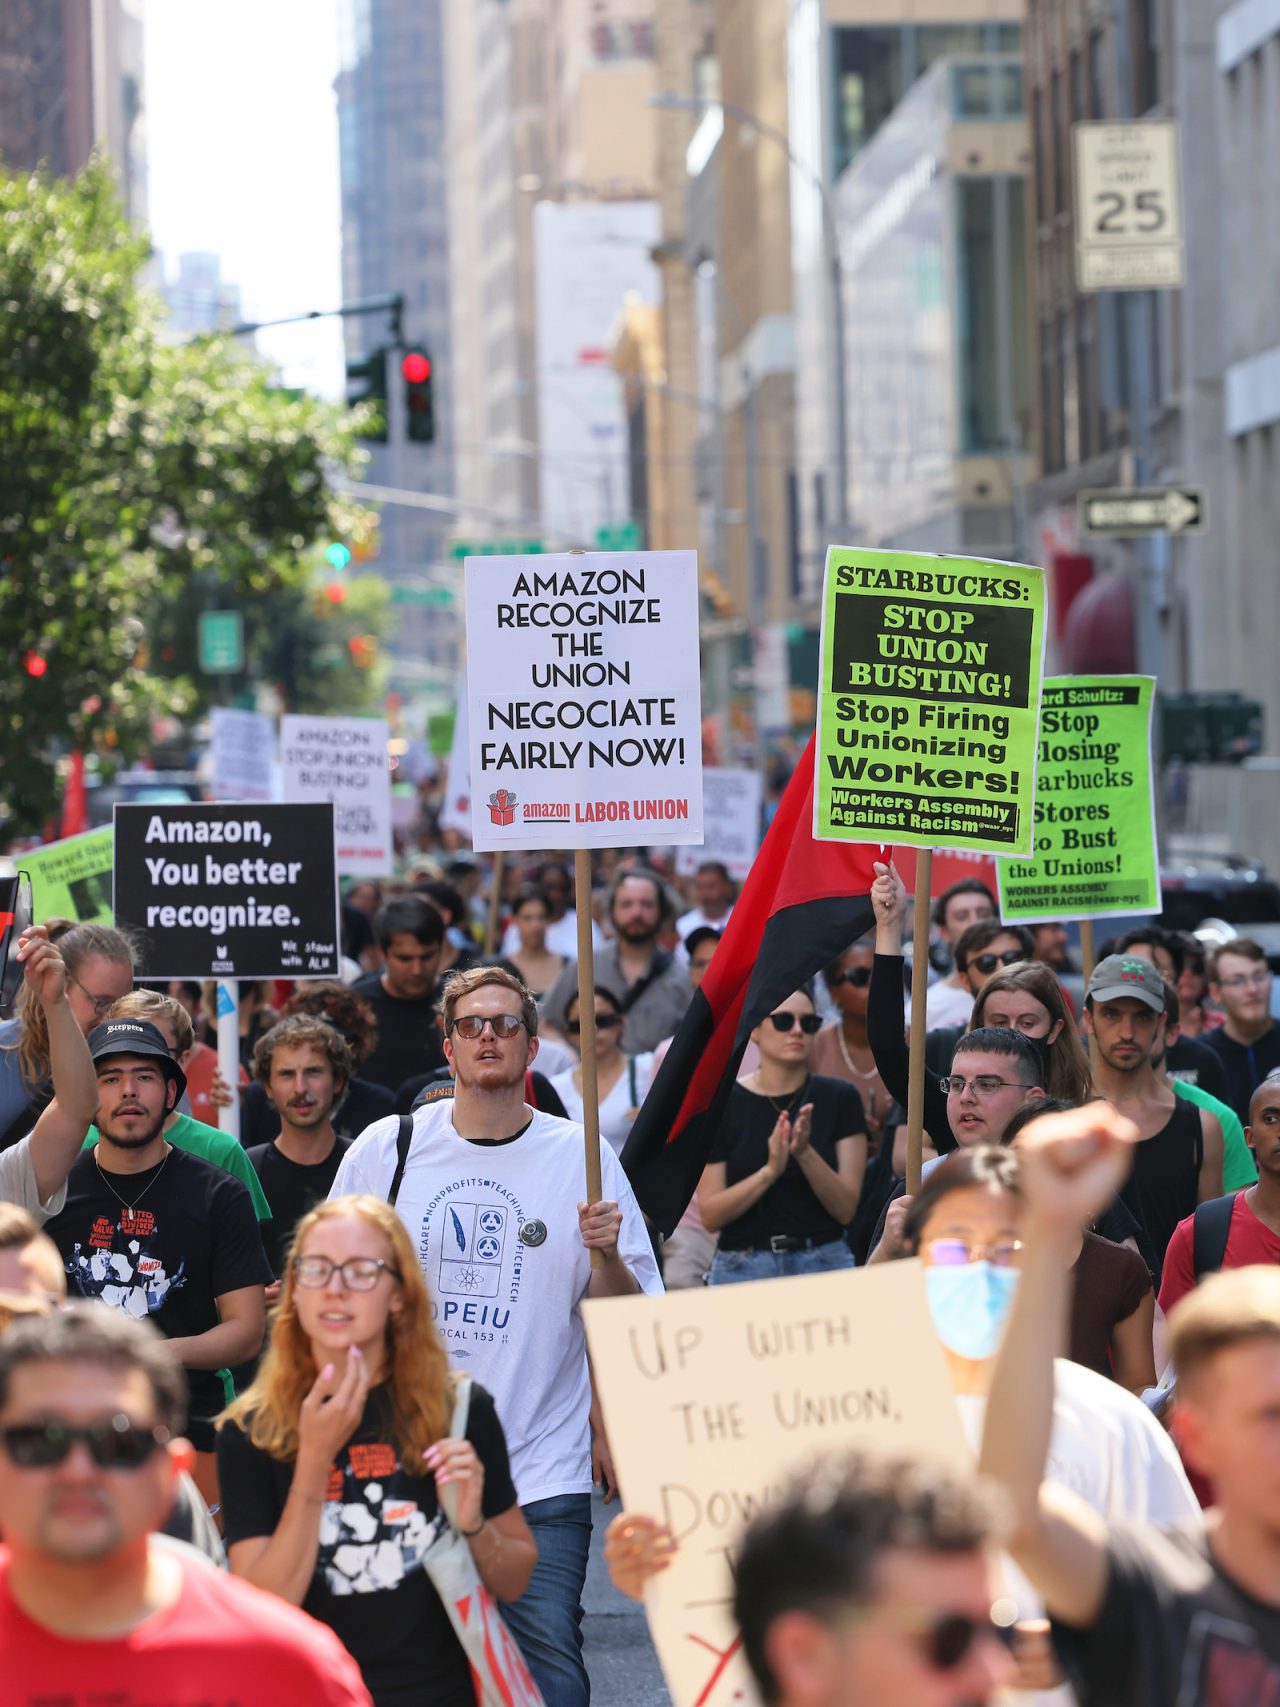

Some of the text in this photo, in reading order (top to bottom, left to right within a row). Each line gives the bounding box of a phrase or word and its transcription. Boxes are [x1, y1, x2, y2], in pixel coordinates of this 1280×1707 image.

[1095, 191, 1166, 233] 25
[512, 569, 645, 597] AMAZON
[836, 565, 1030, 601] STARBUCKS:
[497, 599, 661, 628] RECOGNIZE
[883, 604, 975, 634] STOP
[551, 632, 603, 657] THE
[877, 634, 988, 665] UNION
[532, 661, 630, 688] UNION
[849, 662, 1012, 698] BUSTING!
[1041, 690, 1125, 704] ard Schultz:
[488, 698, 676, 730] NEGOCIATE
[836, 697, 1010, 740] Stop Firing
[1042, 710, 1099, 737] Stop
[481, 738, 685, 770] FAIRLY NOW!
[836, 728, 1007, 764] Unionizing
[1037, 739, 1121, 765] losing
[827, 755, 1020, 794] Workers!
[1038, 768, 1133, 791] arbucks
[522, 799, 688, 823] amazon LABOR UNION
[831, 807, 906, 825] Against
[910, 814, 978, 833] Racism
[832, 790, 1009, 823] Workers Assembly
[145, 815, 272, 847] Amazon,
[1062, 826, 1117, 849] Bust
[145, 854, 301, 886] You better
[1008, 854, 1121, 878] the Unions!
[1006, 882, 1108, 897] WORKERS ASSEMBLY
[1007, 897, 1049, 909] AGAINST
[147, 896, 301, 935] recognize.
[426, 1178, 483, 1216] NONPROFITS
[490, 1181, 526, 1224] TEACHING
[510, 1276, 520, 1303] TECH
[474, 1332, 494, 1342] 153
[672, 1400, 746, 1445] THE
